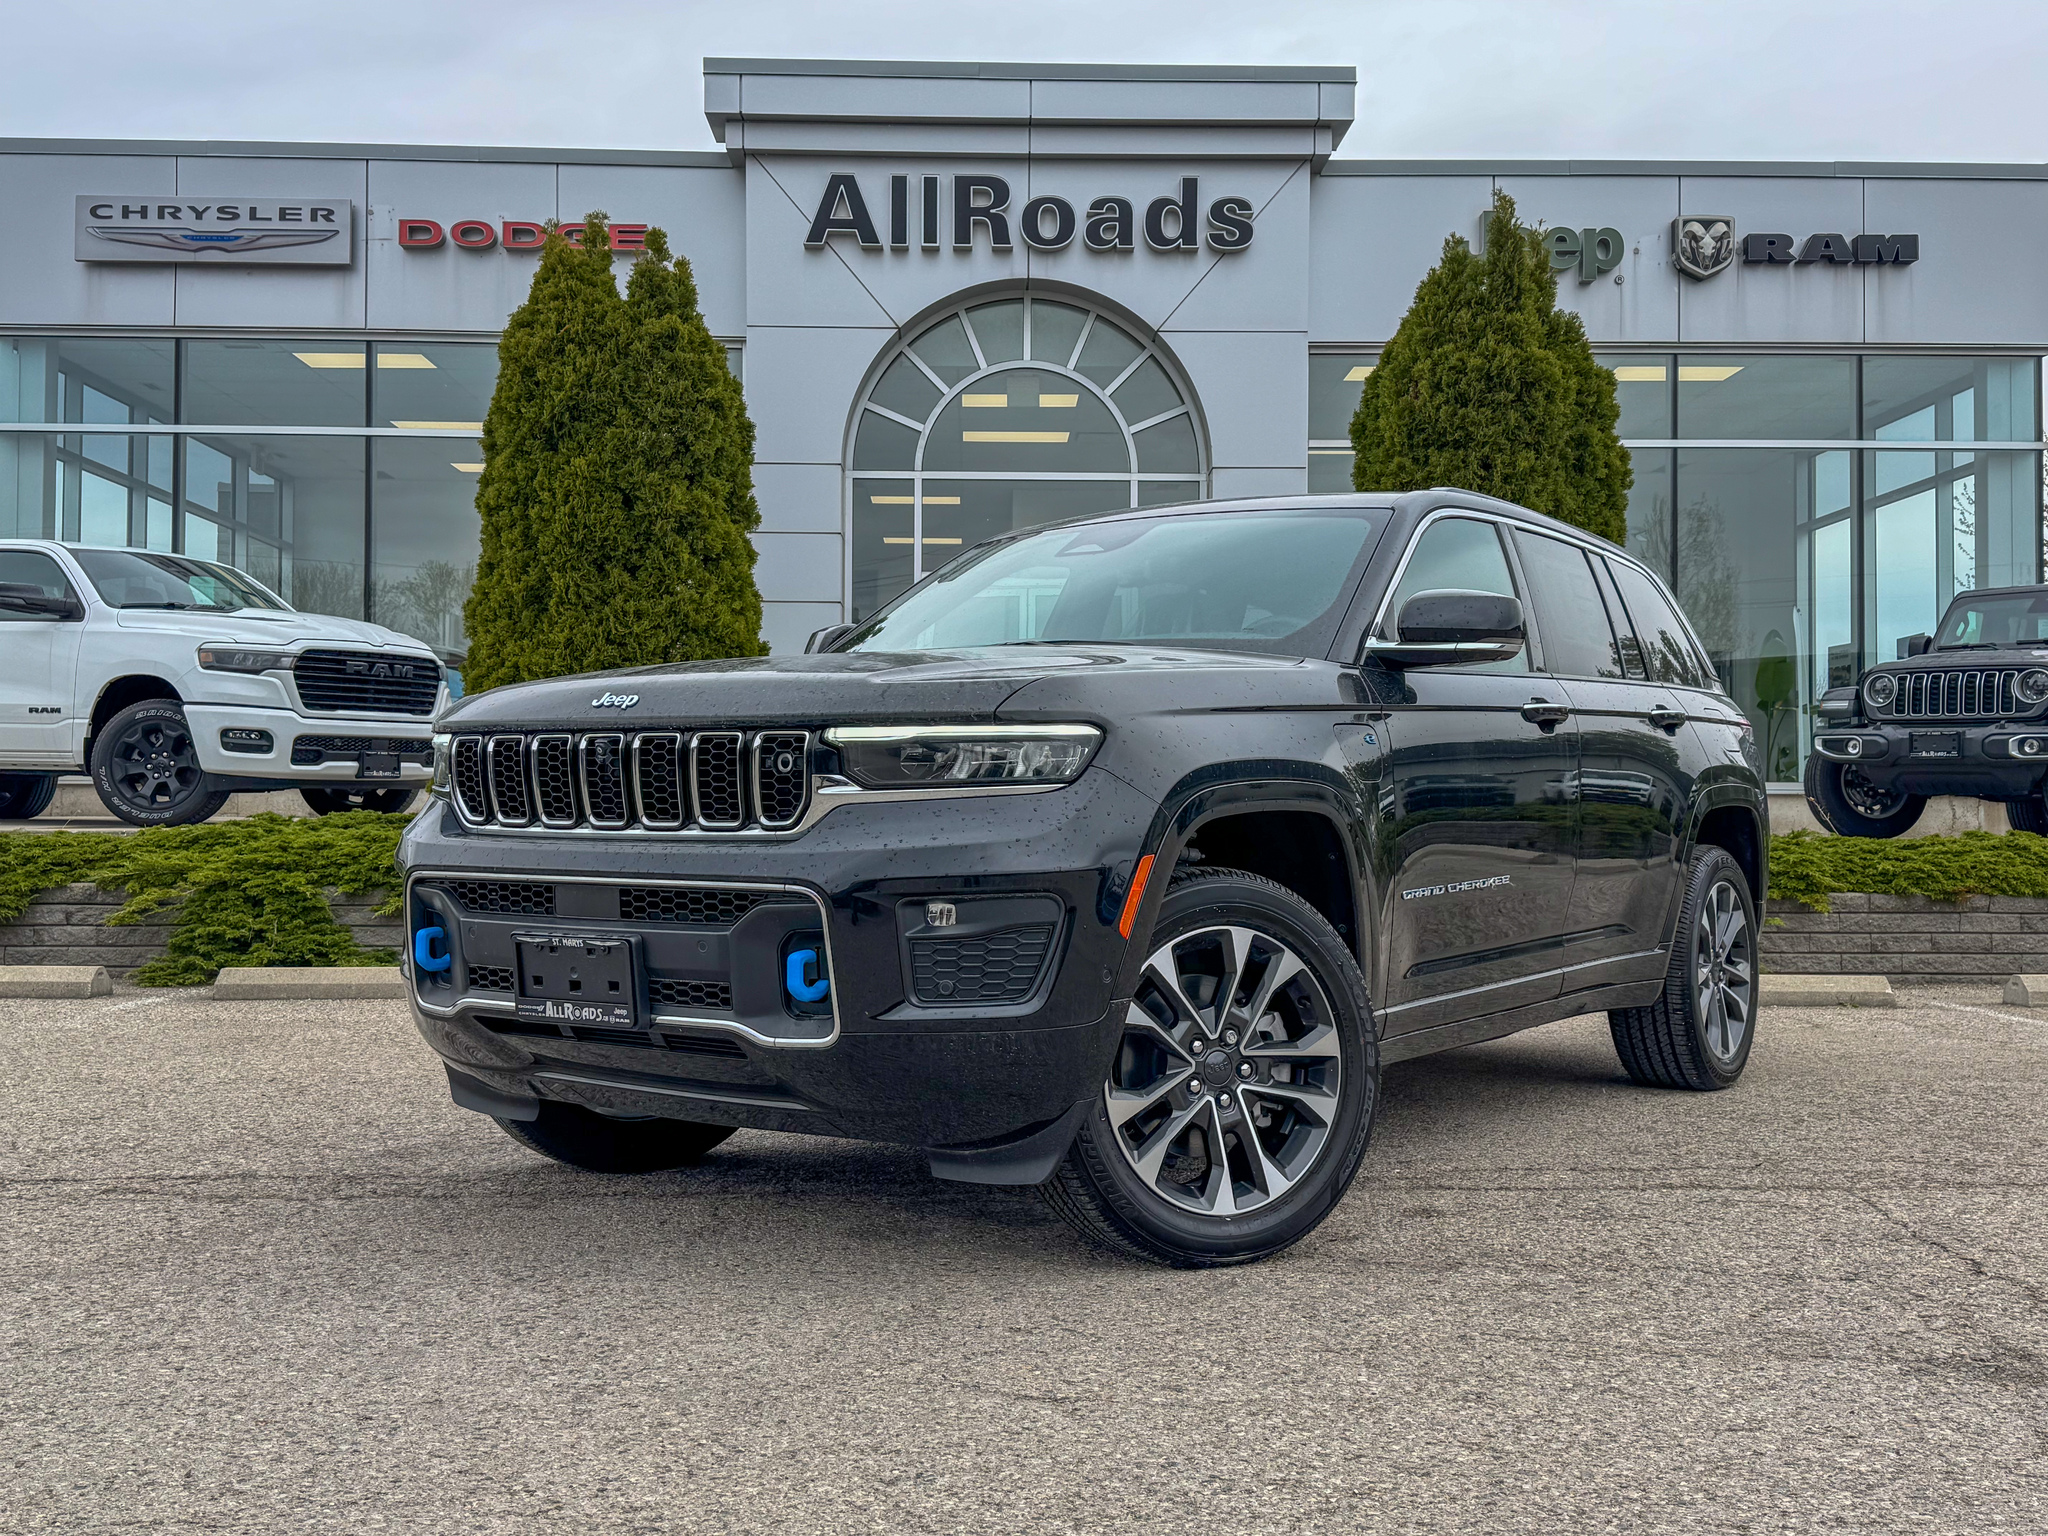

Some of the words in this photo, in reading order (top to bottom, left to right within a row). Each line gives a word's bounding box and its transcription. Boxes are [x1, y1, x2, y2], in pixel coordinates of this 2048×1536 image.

[89, 204, 336, 222] CHRYSLER
[803, 172, 1255, 253] AllRoads
[1457, 211, 1624, 284] ep
[1743, 233, 1919, 264] RAM
[347, 661, 414, 677] RAM
[591, 692, 639, 709] Jeep
[1402, 885, 1445, 900] GRAND
[1447, 875, 1510, 892] CHEROKEE
[552, 938, 561, 946] ST.
[562, 938, 584, 947] MARYS
[613, 1007, 628, 1017] Jeep
